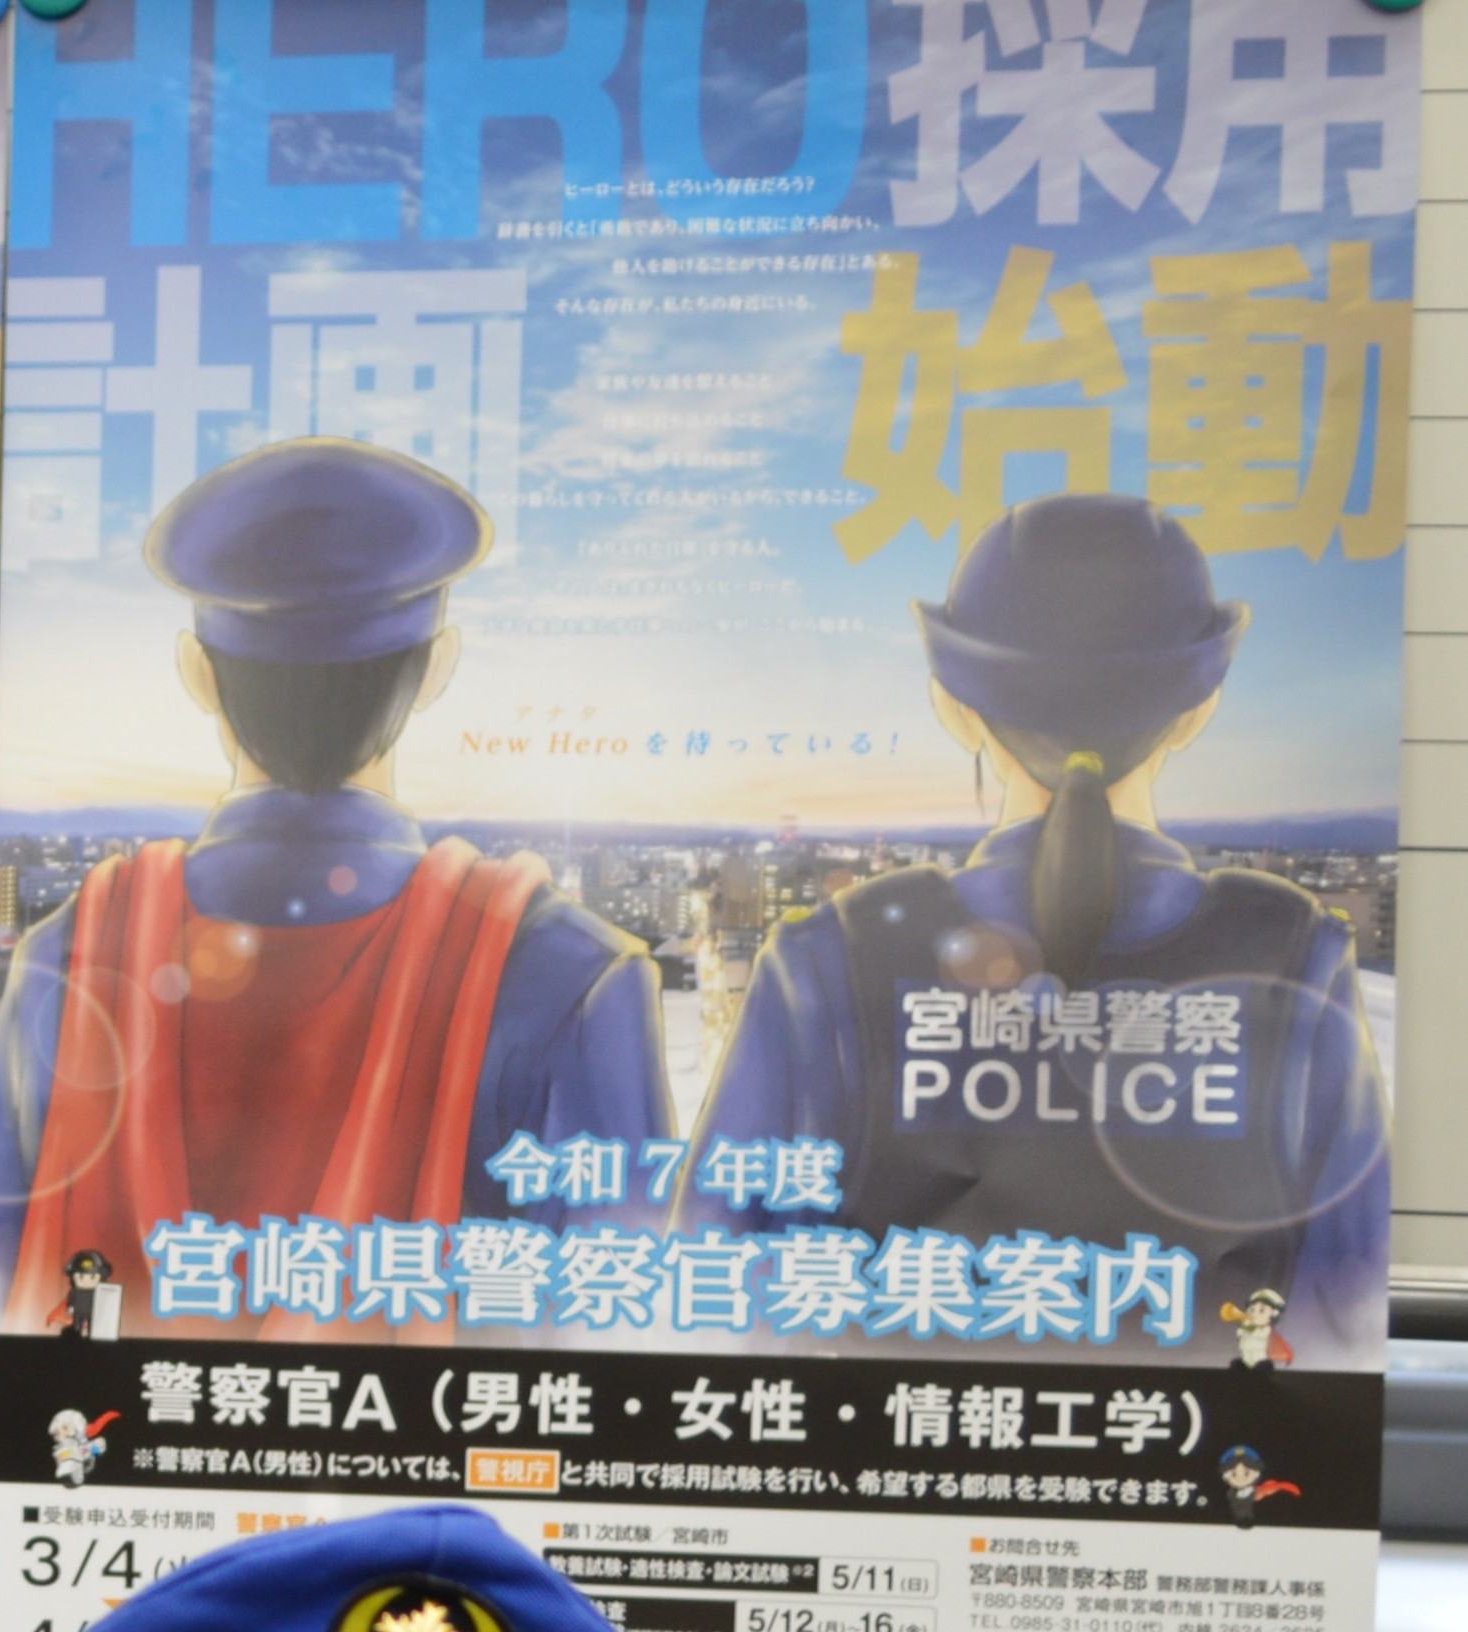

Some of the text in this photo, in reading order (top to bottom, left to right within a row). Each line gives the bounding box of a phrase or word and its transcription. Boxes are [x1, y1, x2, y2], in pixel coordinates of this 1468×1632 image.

[831, 241, 1414, 564] 始動
[459, 728, 533, 757] New
[546, 728, 630, 758] Hero
[903, 988, 1242, 1056] 宮崎県警察
[903, 1058, 1240, 1127] POLICE
[491, 1135, 840, 1207] 令和7年度
[152, 1219, 1193, 1341] 宮崎県警察官募集案内
[42, 1506, 215, 1531] 受験申込受付期間
[988, 1538, 1080, 1557] お問合せ先
[969, 1563, 1148, 1592] 宮崎県警察本部
